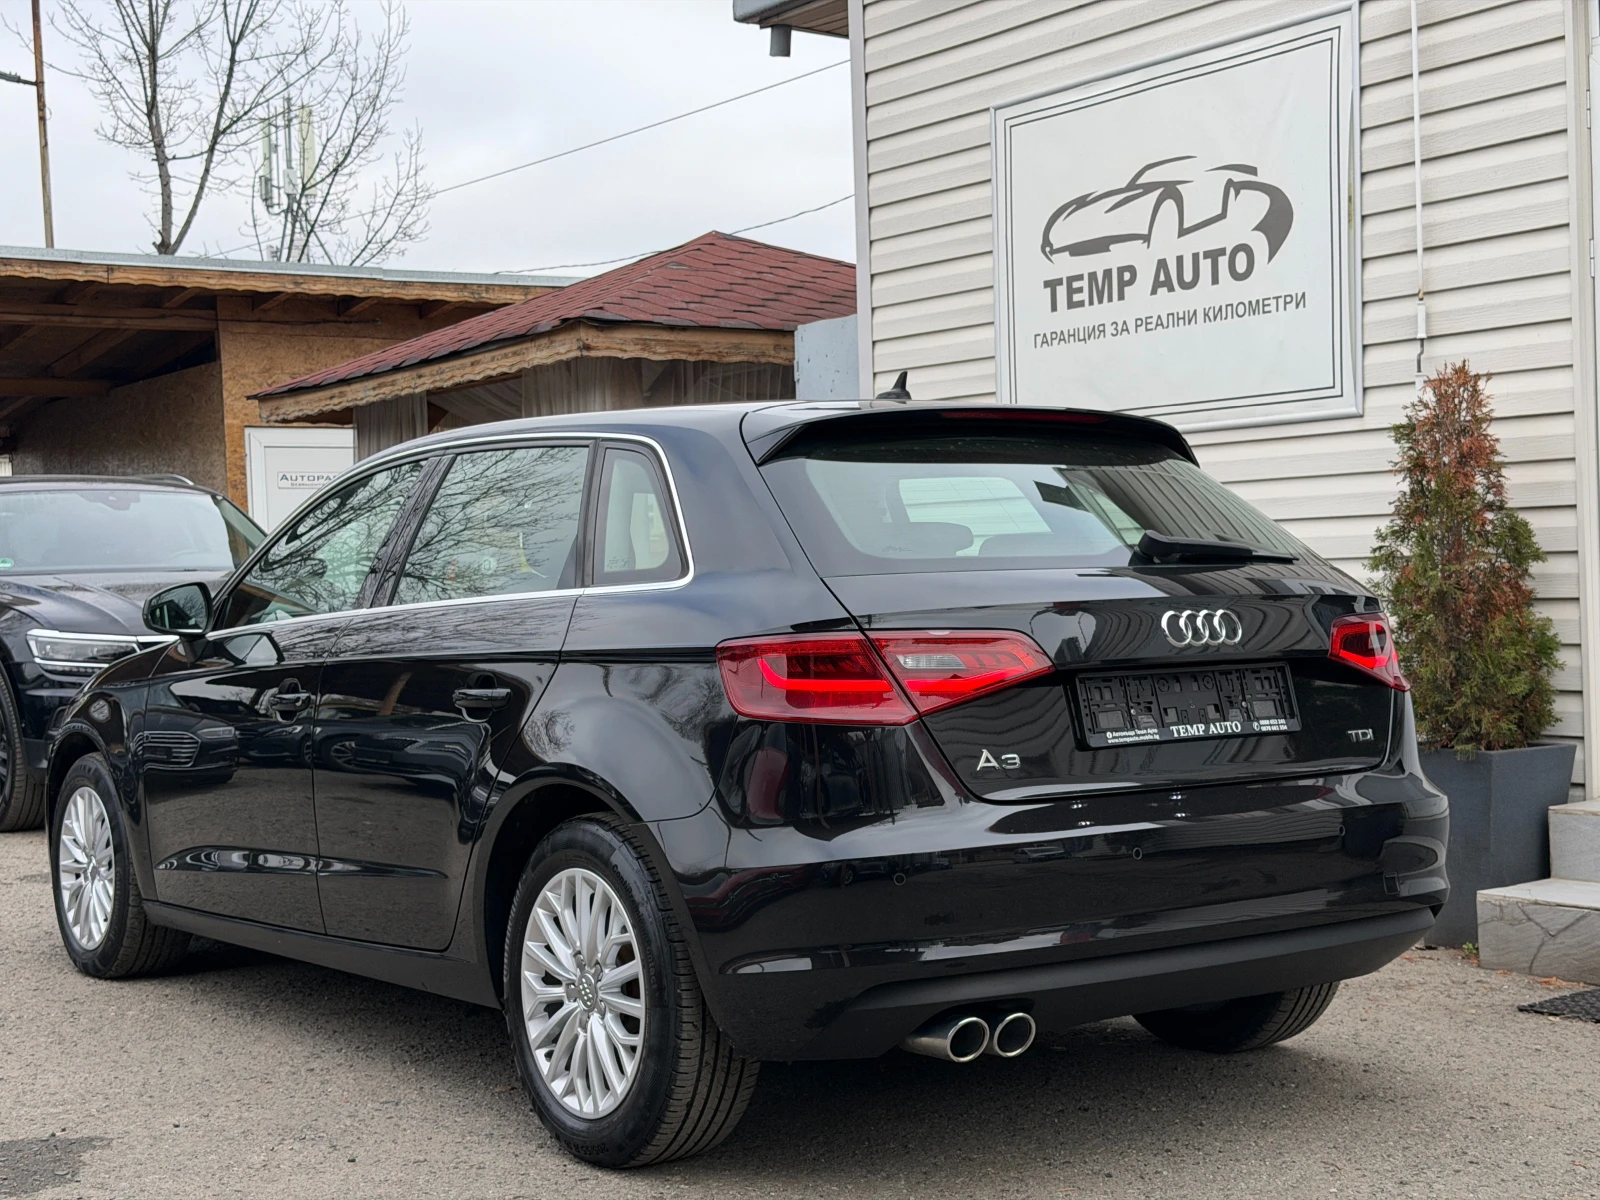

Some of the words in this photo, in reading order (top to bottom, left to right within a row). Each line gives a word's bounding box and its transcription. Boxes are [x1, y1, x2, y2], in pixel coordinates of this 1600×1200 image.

[1043, 264, 1138, 313] TEMP
[1150, 243, 1255, 296] AUTO
[1033, 323, 1106, 349] ГАРАНЦИЯ
[1110, 320, 1131, 338] ЗА
[1134, 310, 1198, 333] РЕАЛНИ
[1203, 291, 1307, 324] КИЛОМЕТРИ
[1170, 723, 1205, 738] TEMP
[1209, 721, 1242, 734] AUTO
[1346, 728, 1375, 742] TDI
[976, 749, 1021, 771] A3
